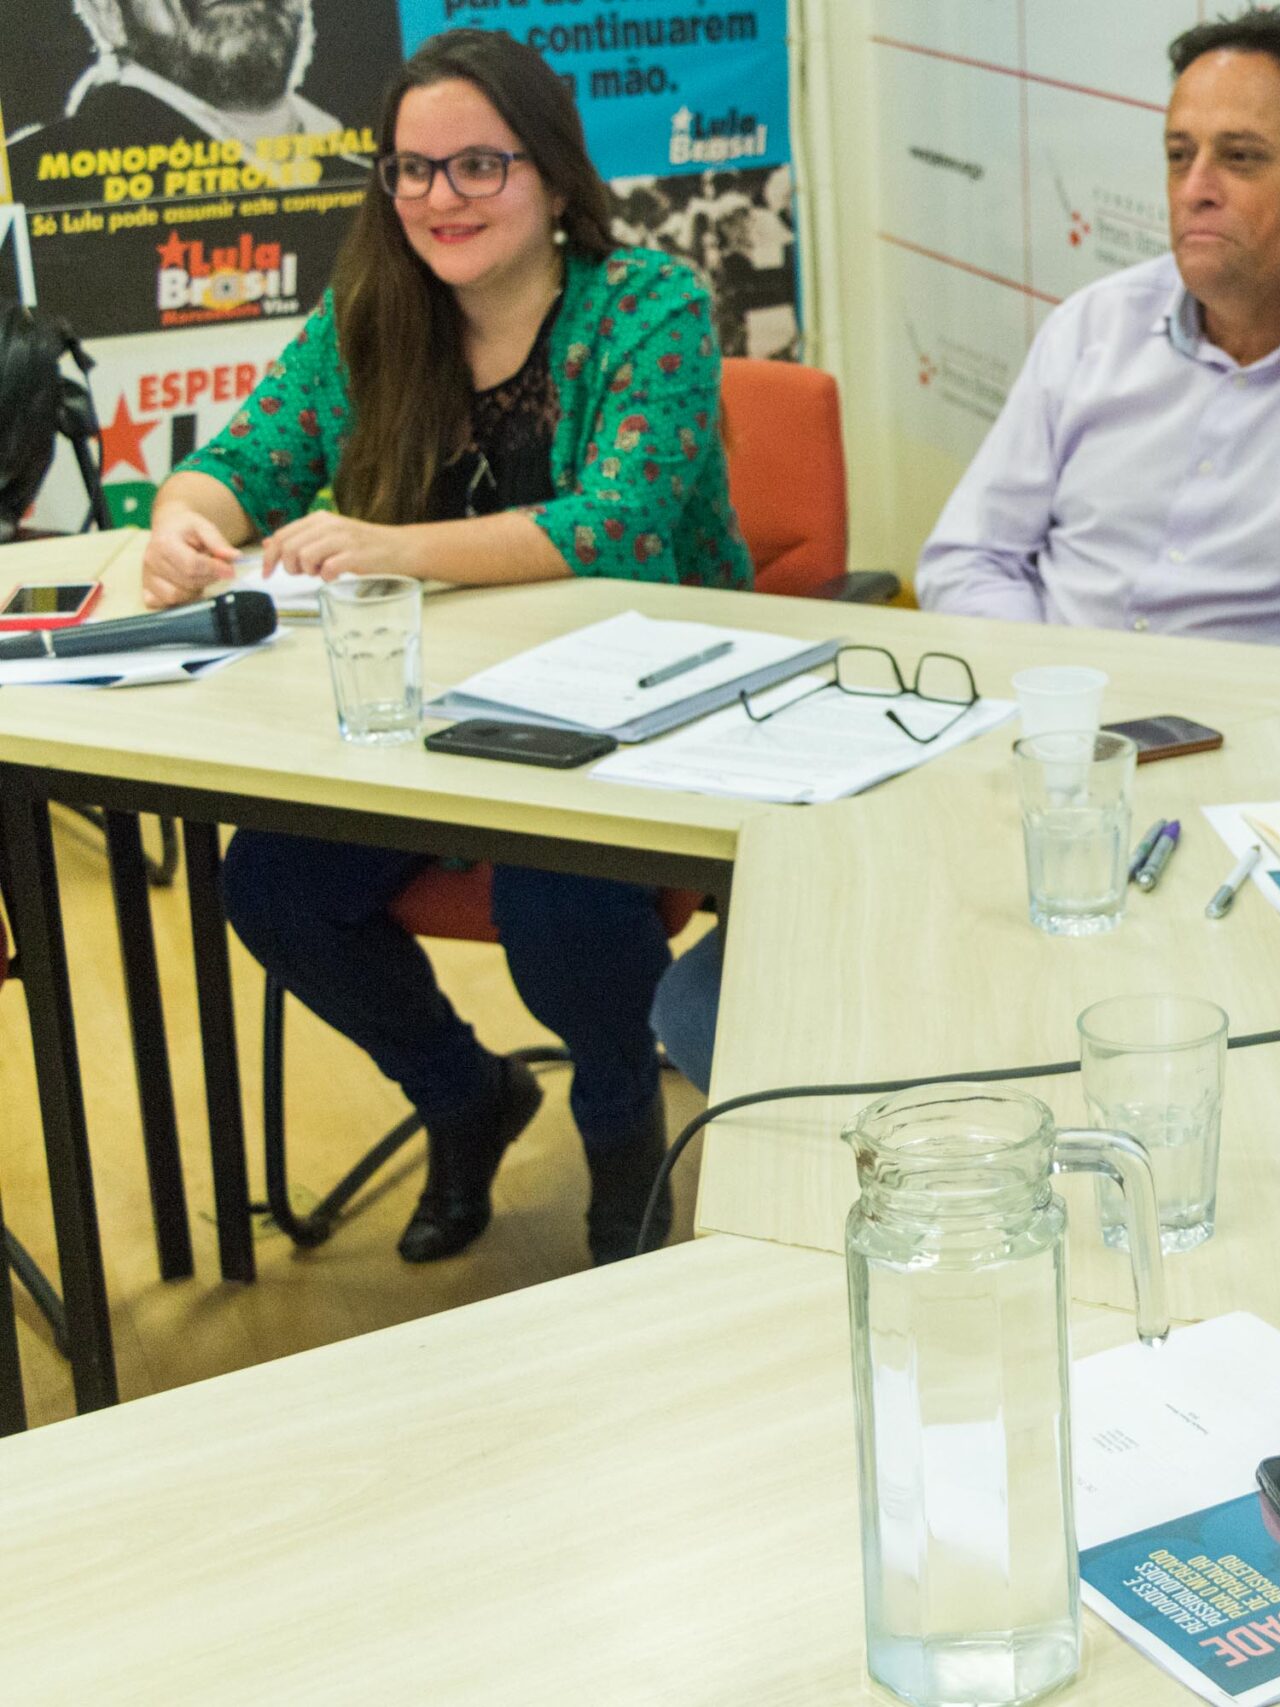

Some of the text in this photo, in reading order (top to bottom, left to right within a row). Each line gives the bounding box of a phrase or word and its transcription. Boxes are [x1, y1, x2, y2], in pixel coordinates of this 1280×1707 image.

[527, 11, 758, 52] continuarem
[591, 57, 679, 98] mão.
[38, 128, 378, 180] MONOPÓLIO ESTATAL
[104, 173, 154, 202] DO
[62, 209, 104, 234] Lula
[190, 233, 280, 278] Lula
[139, 360, 277, 412] ESPER
[1123, 1576, 1207, 1634] REALIDADES E
[1134, 1562, 1229, 1627] POSSIBILIDADES
[1149, 1549, 1249, 1619] PARA O MERCADO
[1187, 1555, 1270, 1611] DE TRABALHO
